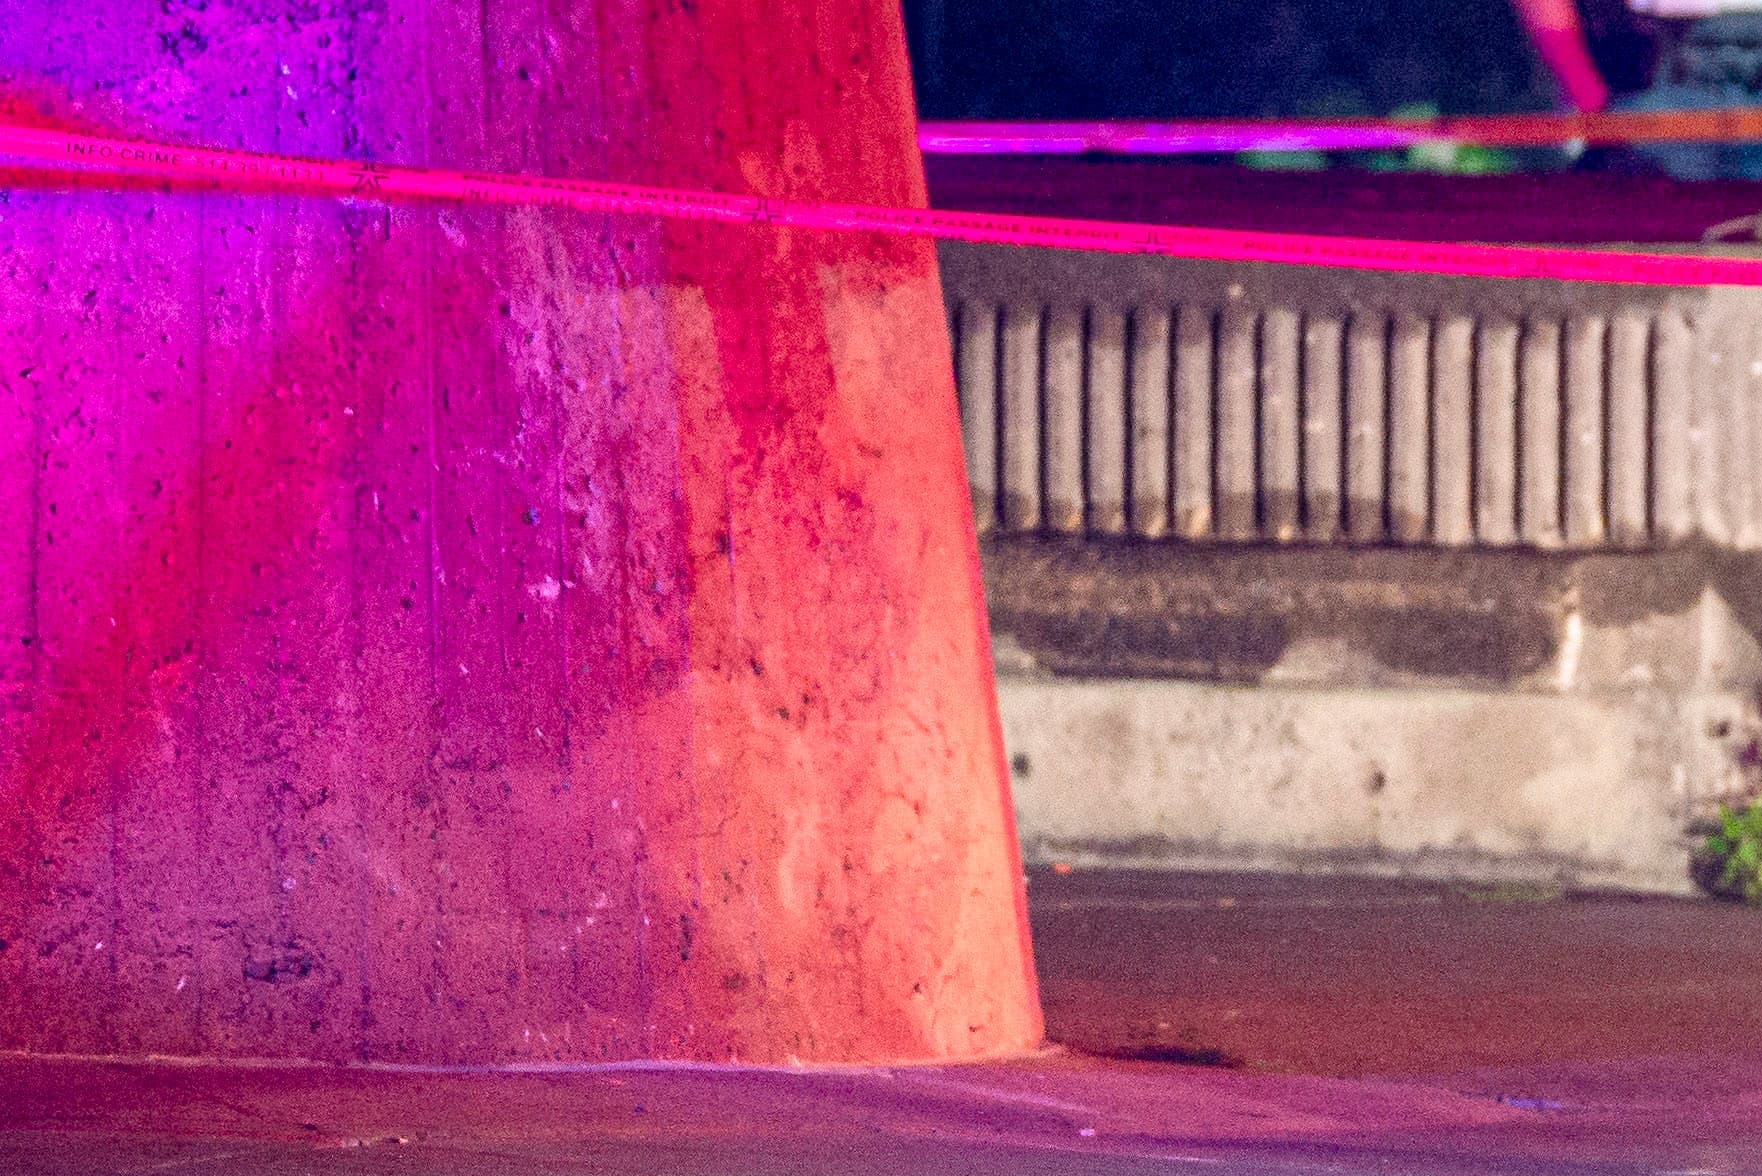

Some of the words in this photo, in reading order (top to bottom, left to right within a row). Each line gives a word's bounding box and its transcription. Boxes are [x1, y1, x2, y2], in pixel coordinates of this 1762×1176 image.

[66, 142, 113, 158] INFO
[120, 148, 182, 166] CRIME
[856, 210, 922, 225] POLICE
[932, 216, 1020, 233] PASSAGE
[1029, 224, 1120, 241] INTERDIT
